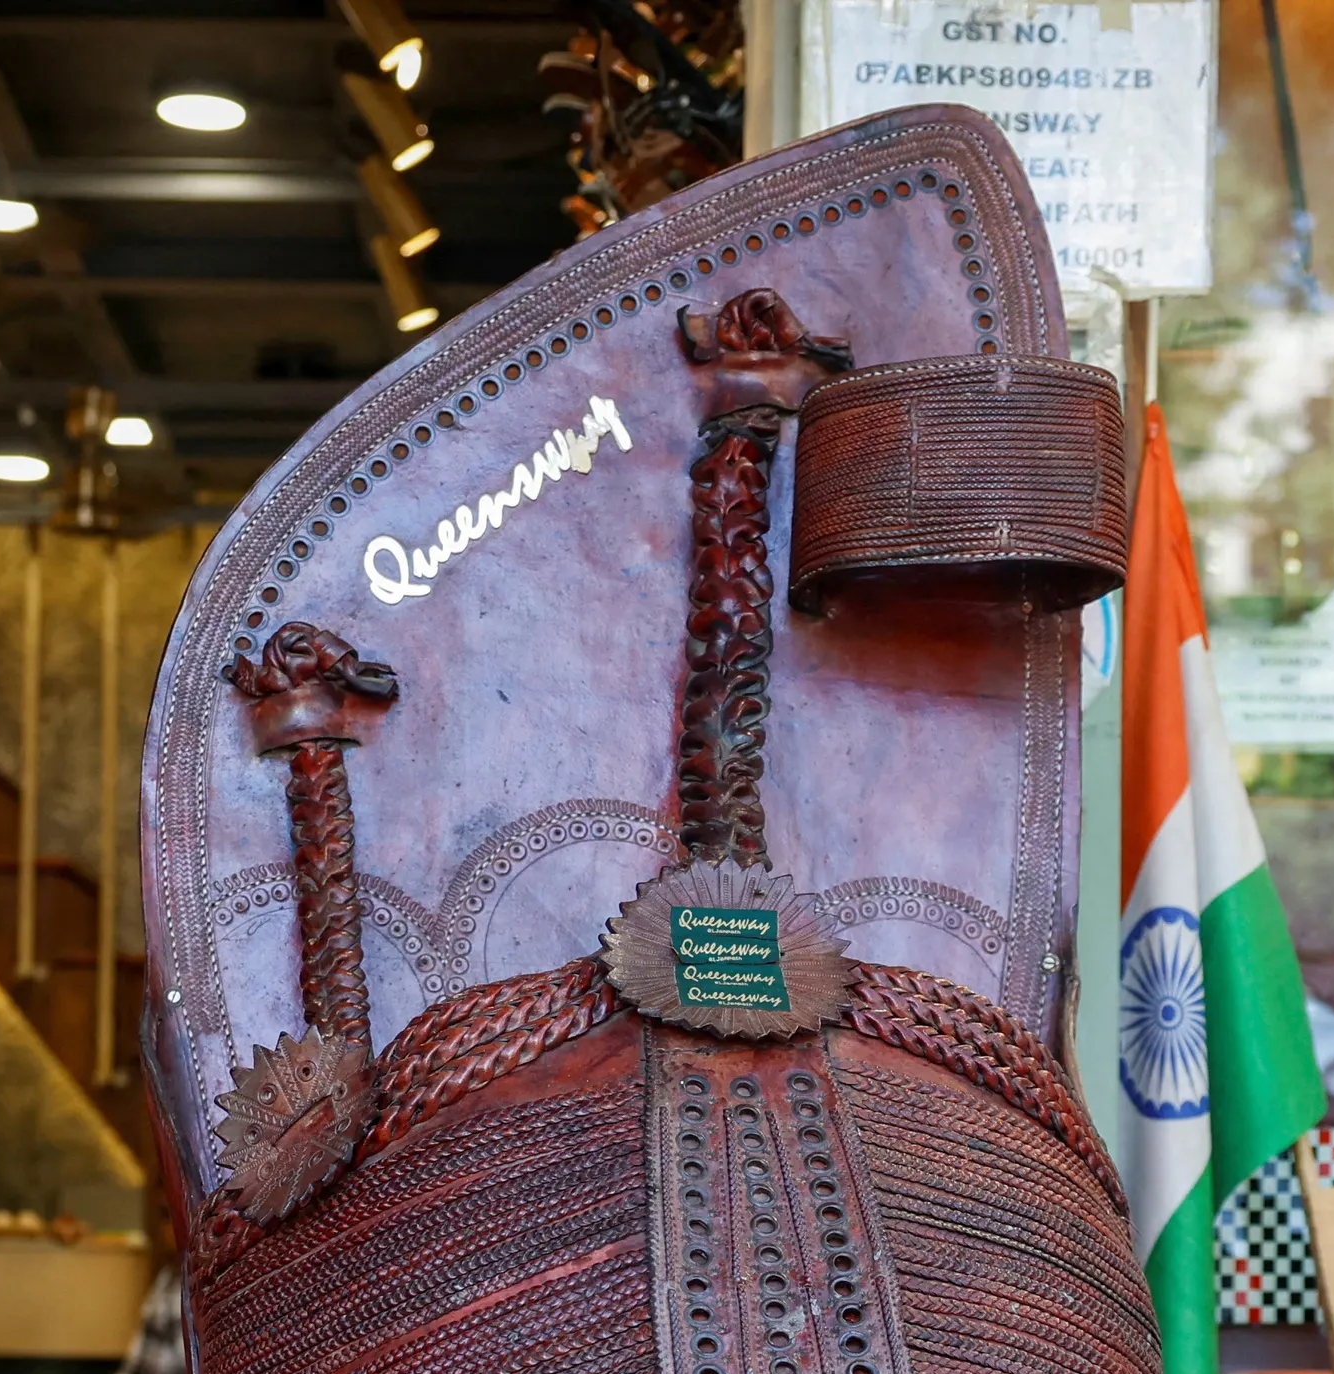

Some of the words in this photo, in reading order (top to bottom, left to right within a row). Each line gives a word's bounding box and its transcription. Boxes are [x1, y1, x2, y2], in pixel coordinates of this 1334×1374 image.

[943, 21, 1003, 42] GST
[1016, 22, 1067, 43] NO.
[983, 112, 1102, 133] NSWAY
[1021, 157, 1089, 178] EAR
[1040, 203, 1138, 223] NPATH
[678, 909, 770, 935] Queensway
[680, 938, 771, 959] Queensway
[683, 965, 775, 986] Queensway
[687, 987, 782, 1007] Queensway
